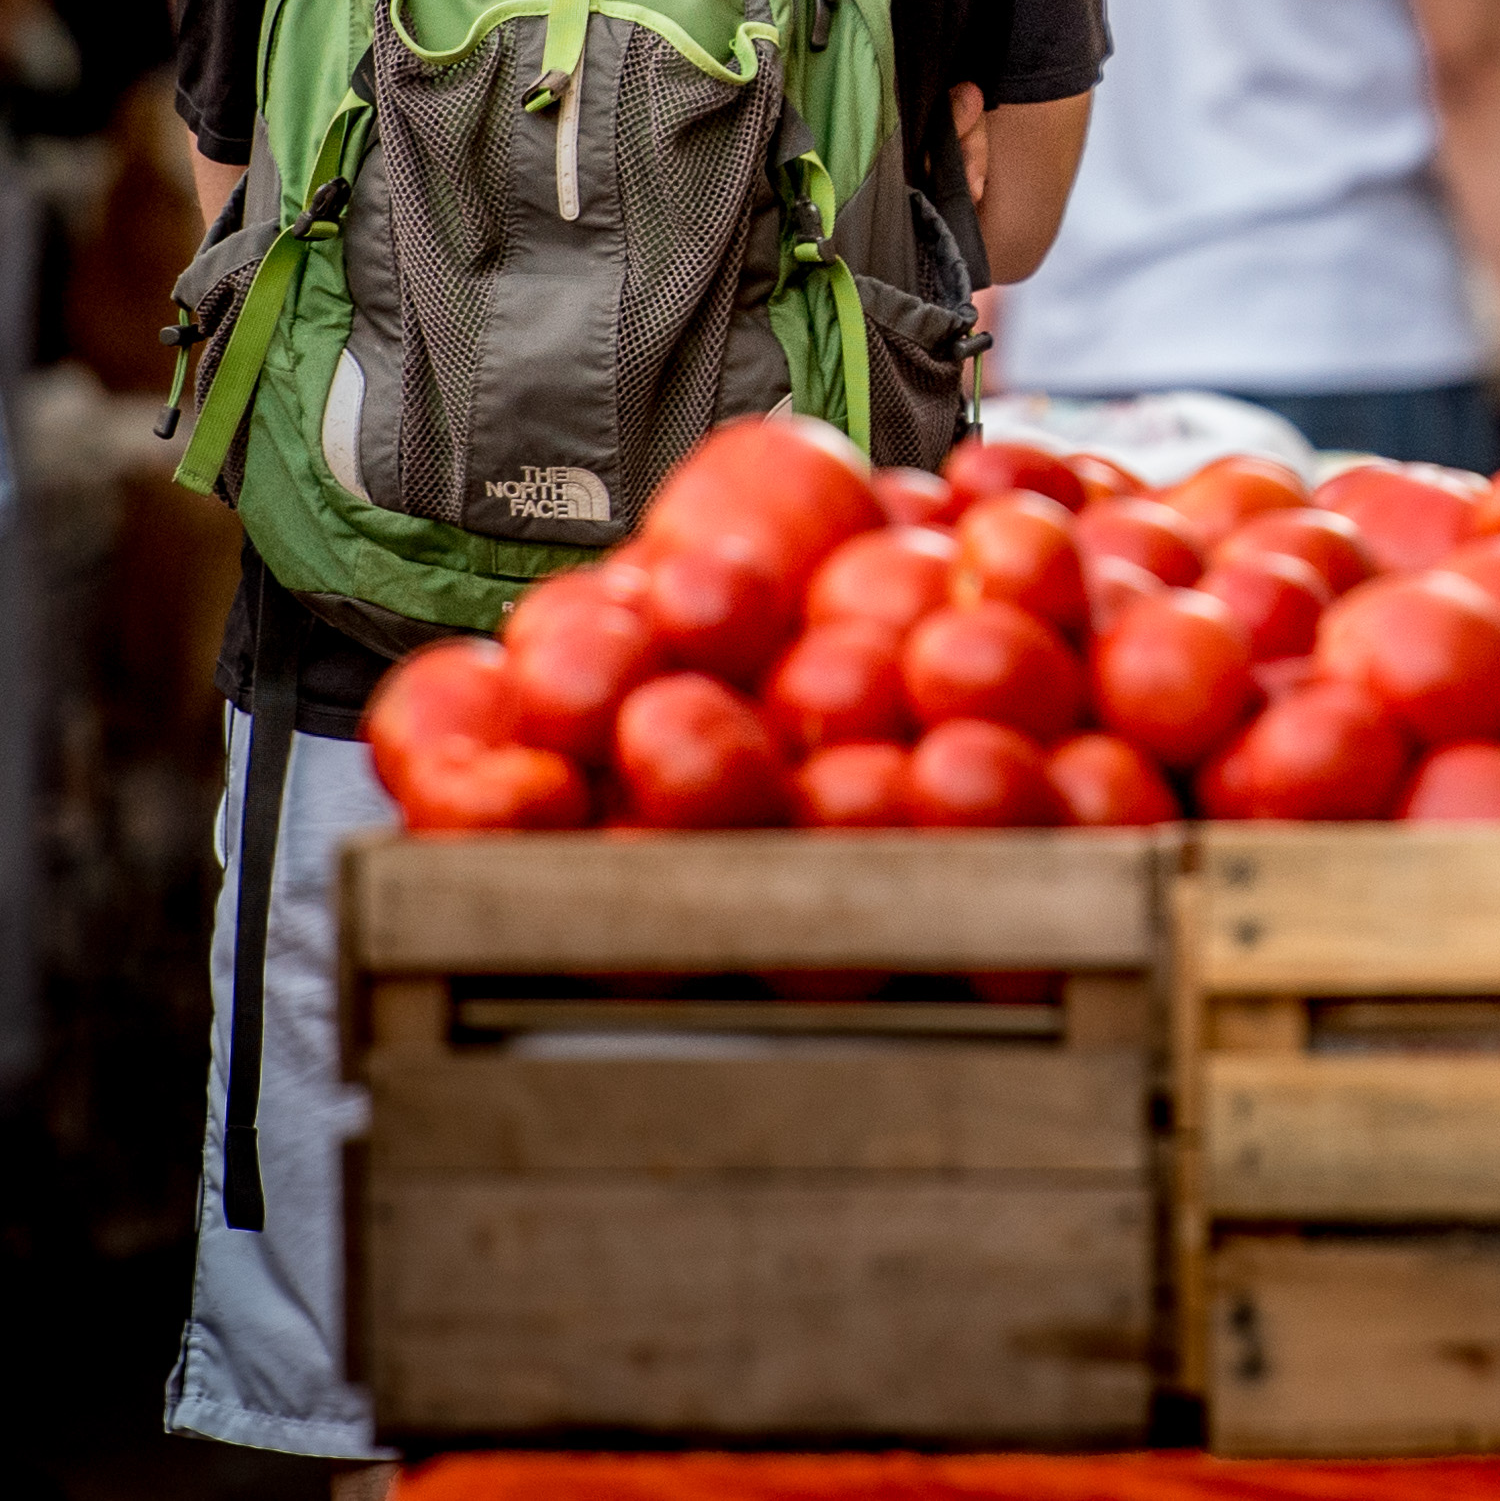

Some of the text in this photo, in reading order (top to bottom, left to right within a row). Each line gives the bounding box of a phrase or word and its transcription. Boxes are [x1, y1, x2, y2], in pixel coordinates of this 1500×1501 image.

[520, 465, 568, 485] THE
[485, 480, 567, 501] NORTH
[510, 498, 569, 519] FACE
